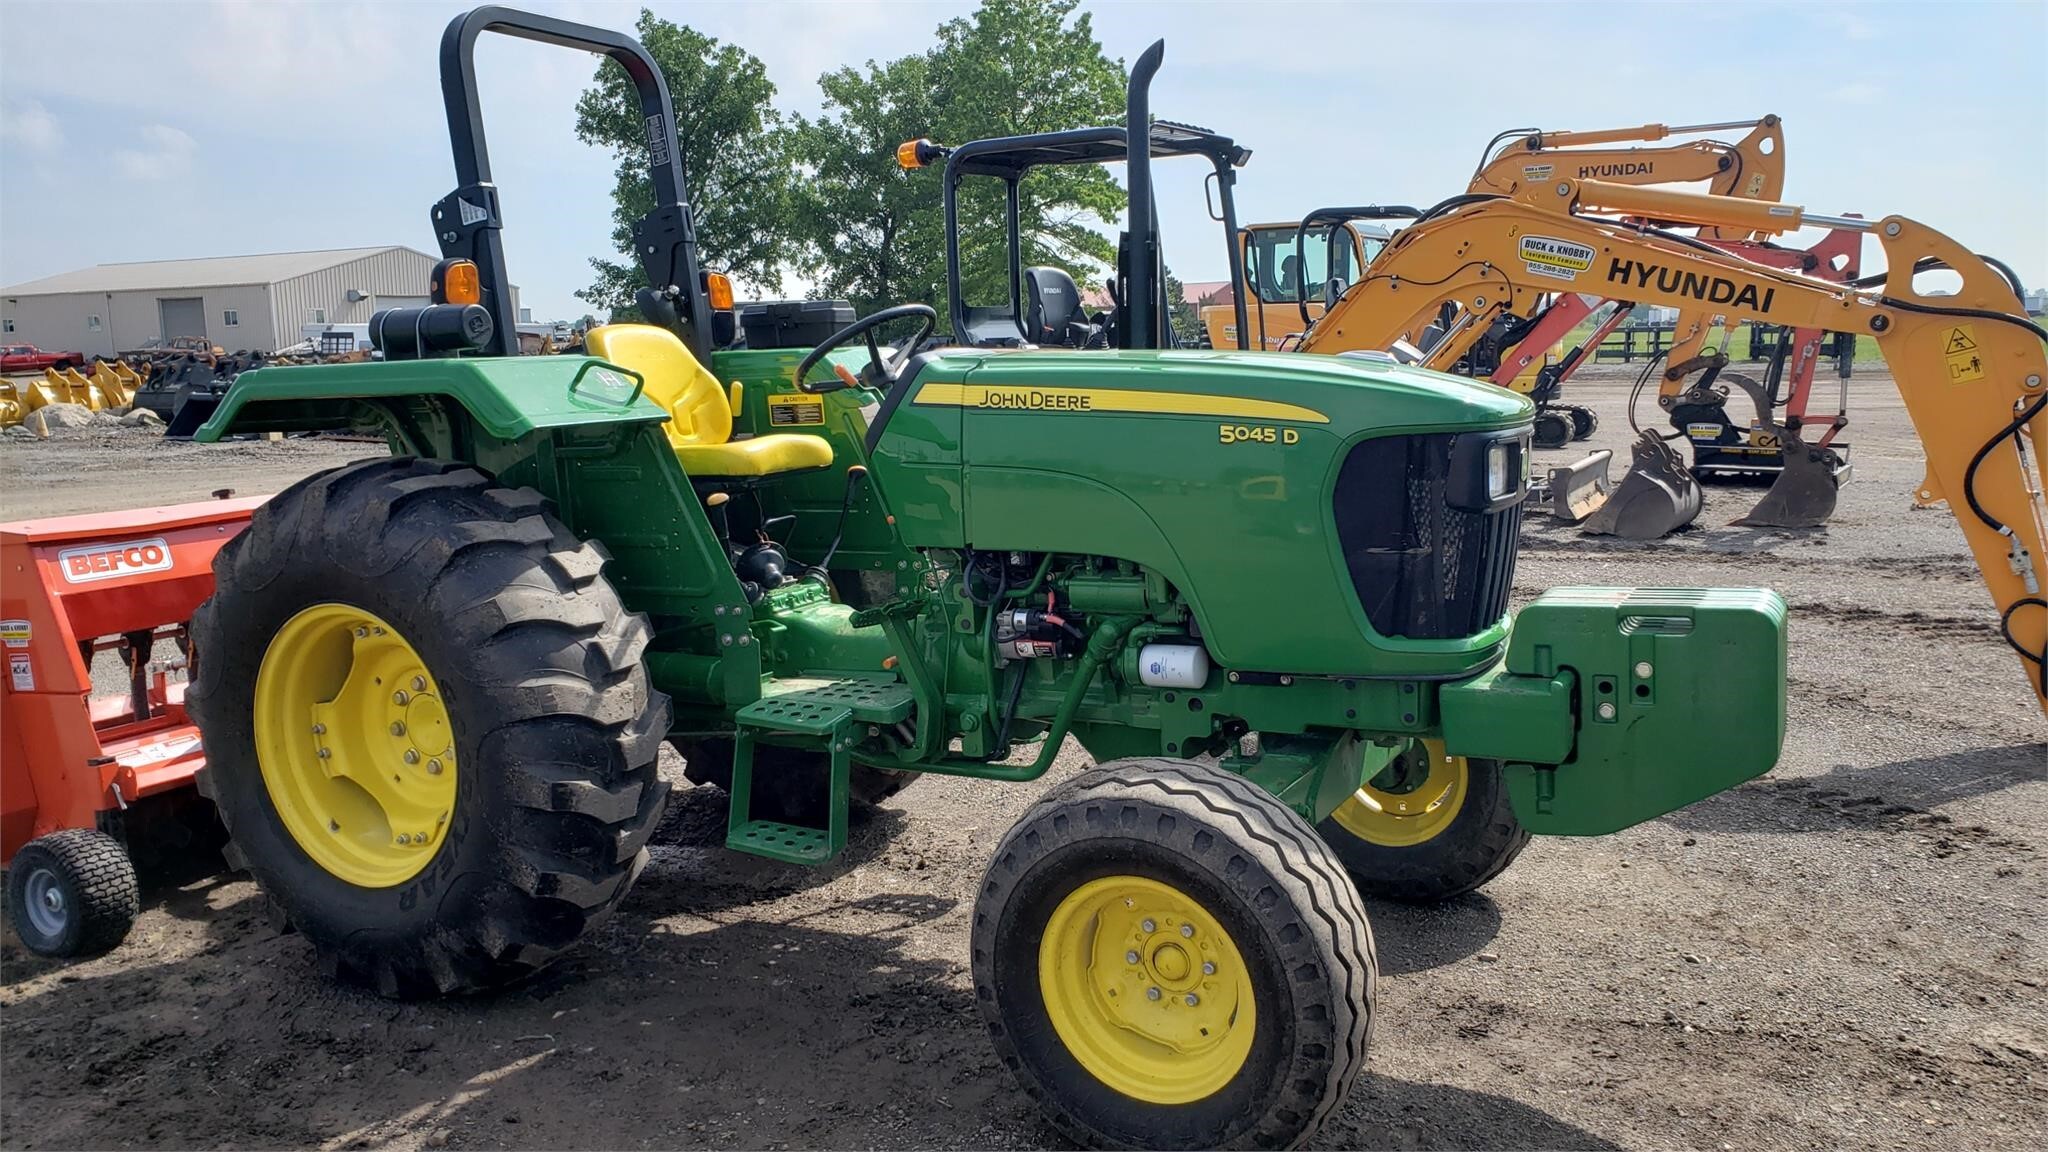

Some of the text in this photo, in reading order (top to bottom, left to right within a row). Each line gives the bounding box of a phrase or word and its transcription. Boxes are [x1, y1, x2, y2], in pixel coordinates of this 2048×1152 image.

[1579, 162, 1653, 178] HYUNDAI
[1525, 239, 1547, 252] BUCK
[1557, 245, 1591, 259] KNOBBY
[1525, 251, 1584, 267] Equipment Company
[1607, 258, 1775, 313] HYUNDAI
[979, 390, 1091, 409] JOHN DEERE
[1219, 424, 1299, 445] 5045 D
[67, 545, 164, 576] BEFCO
